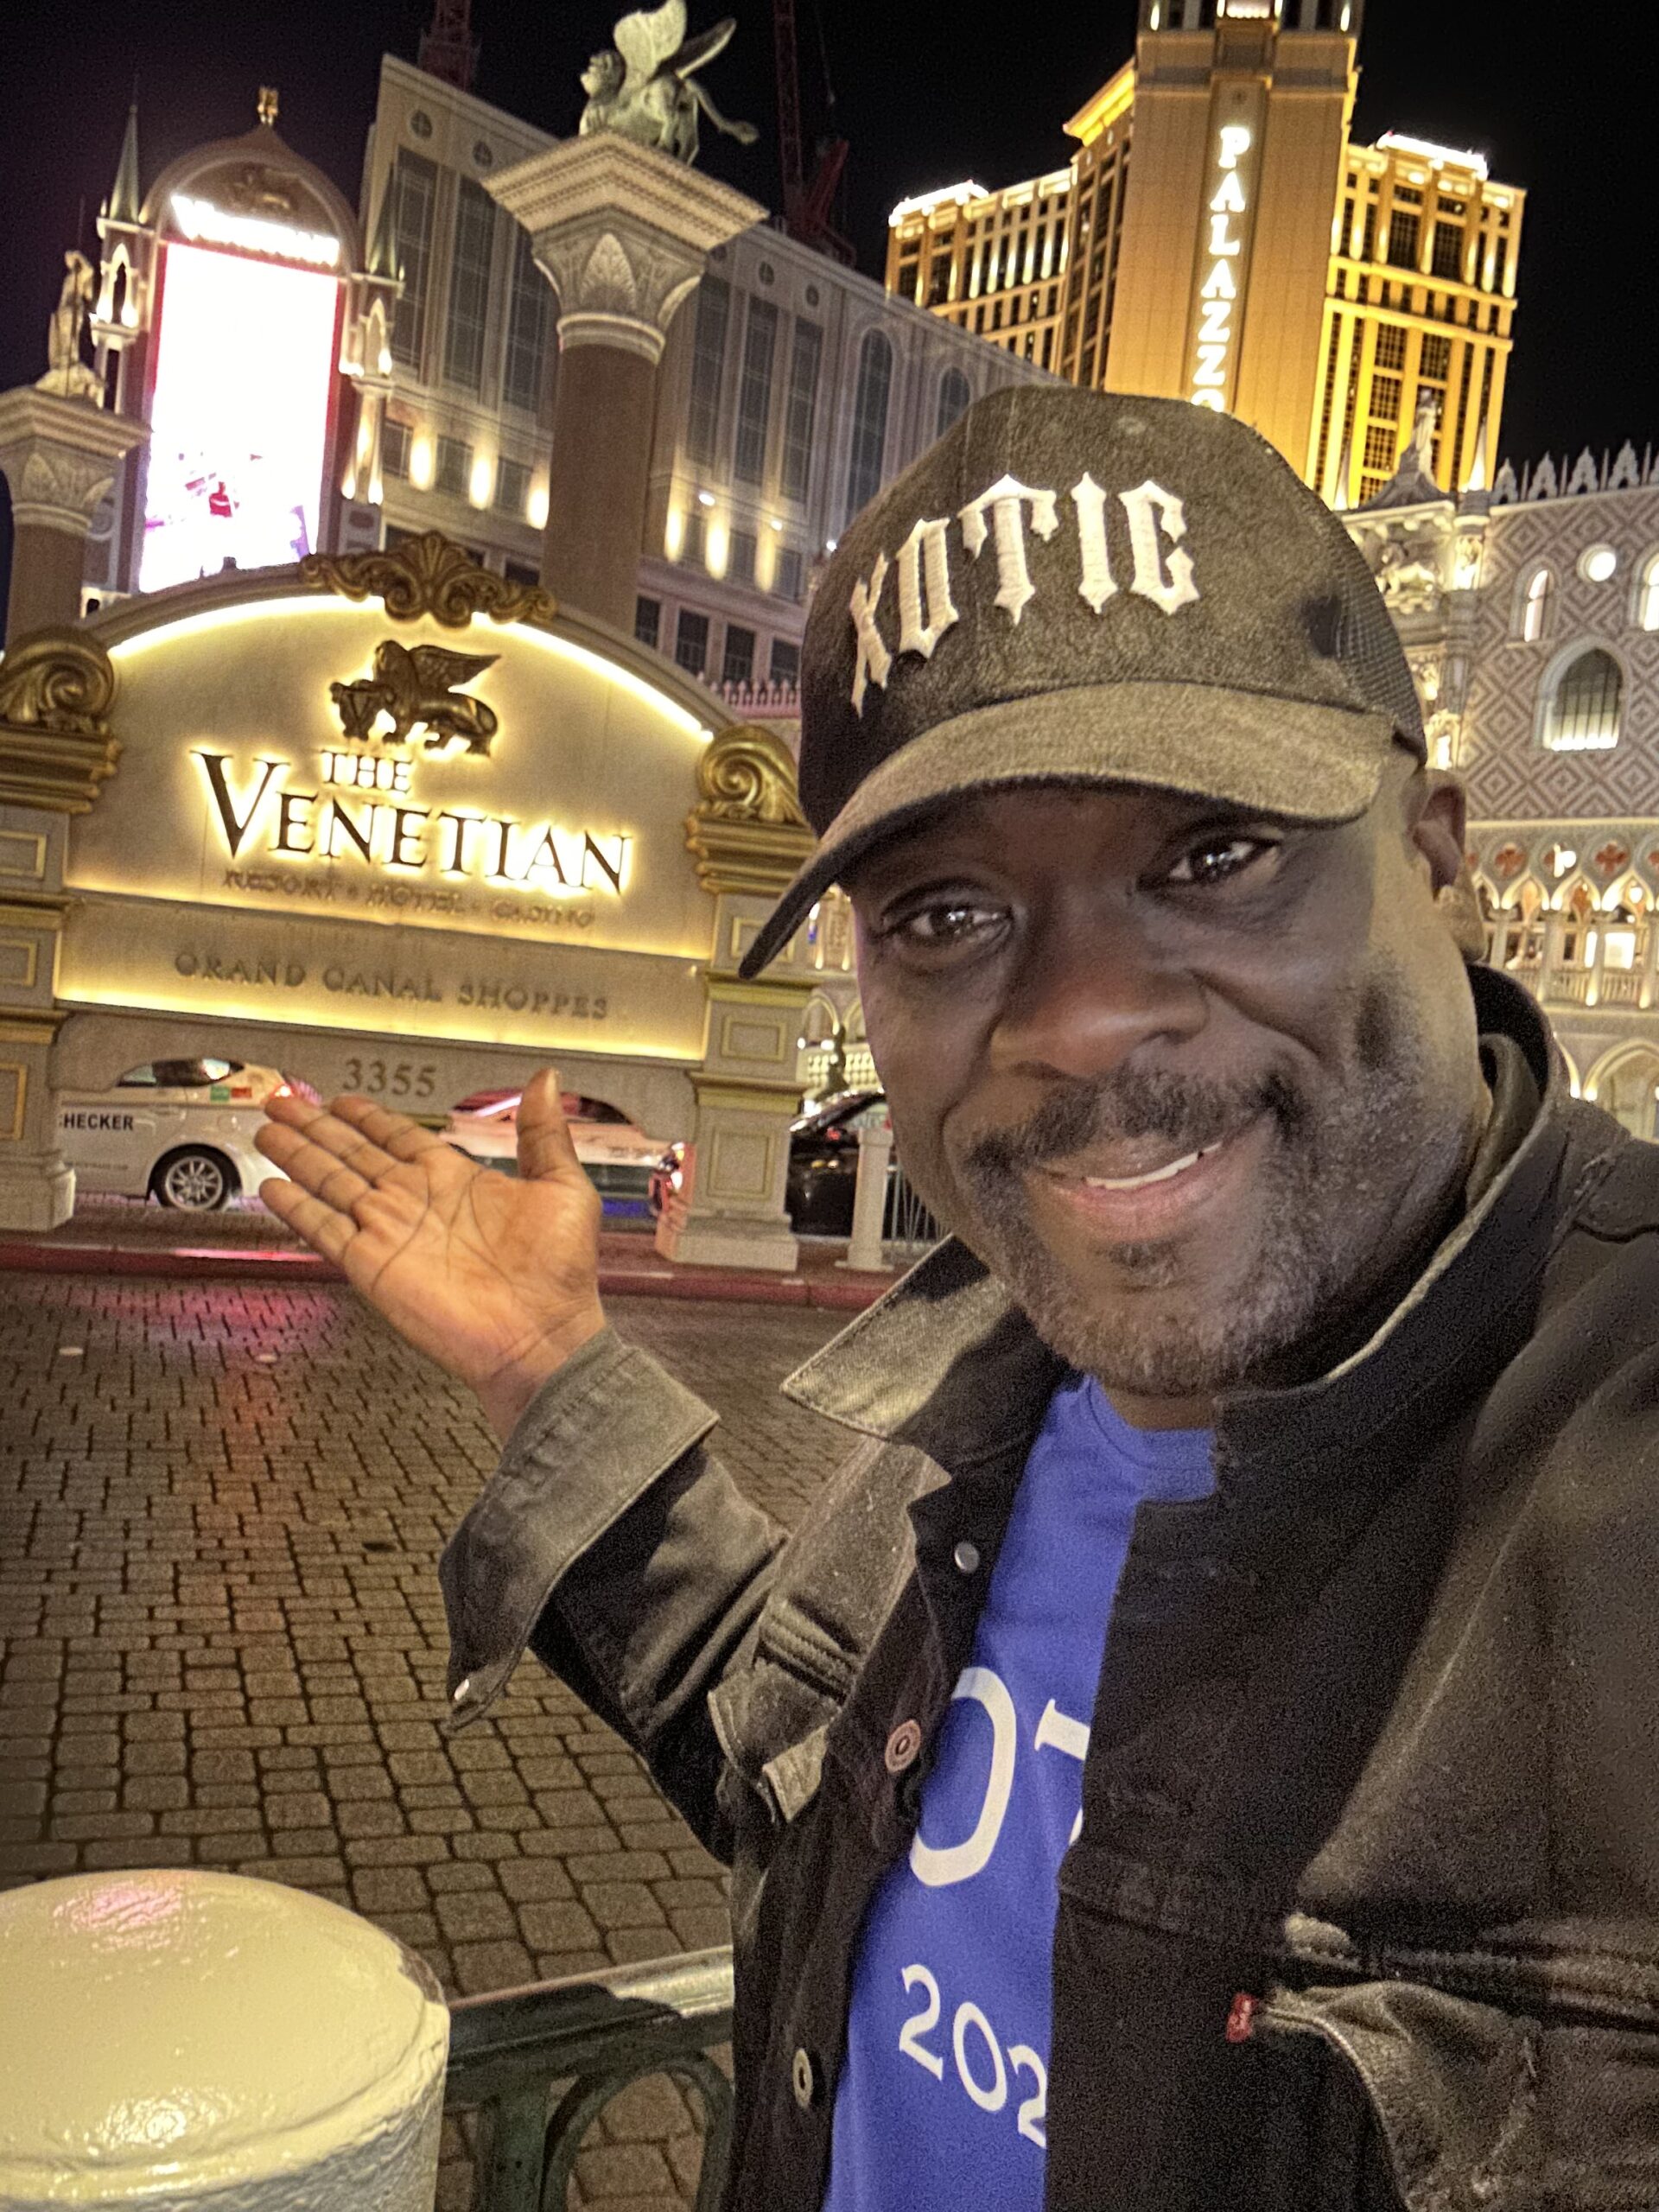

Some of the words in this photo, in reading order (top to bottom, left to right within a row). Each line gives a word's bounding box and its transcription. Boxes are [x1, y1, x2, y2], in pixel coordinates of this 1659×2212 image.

[321, 749, 412, 794] THE
[189, 750, 633, 894] VENETIAN
[175, 952, 306, 987] GRAND
[322, 965, 442, 1003] CANAL
[456, 979, 608, 1020] SHOPPES
[342, 1058, 437, 1098] 3355
[59, 1113, 134, 1132] HECKER
